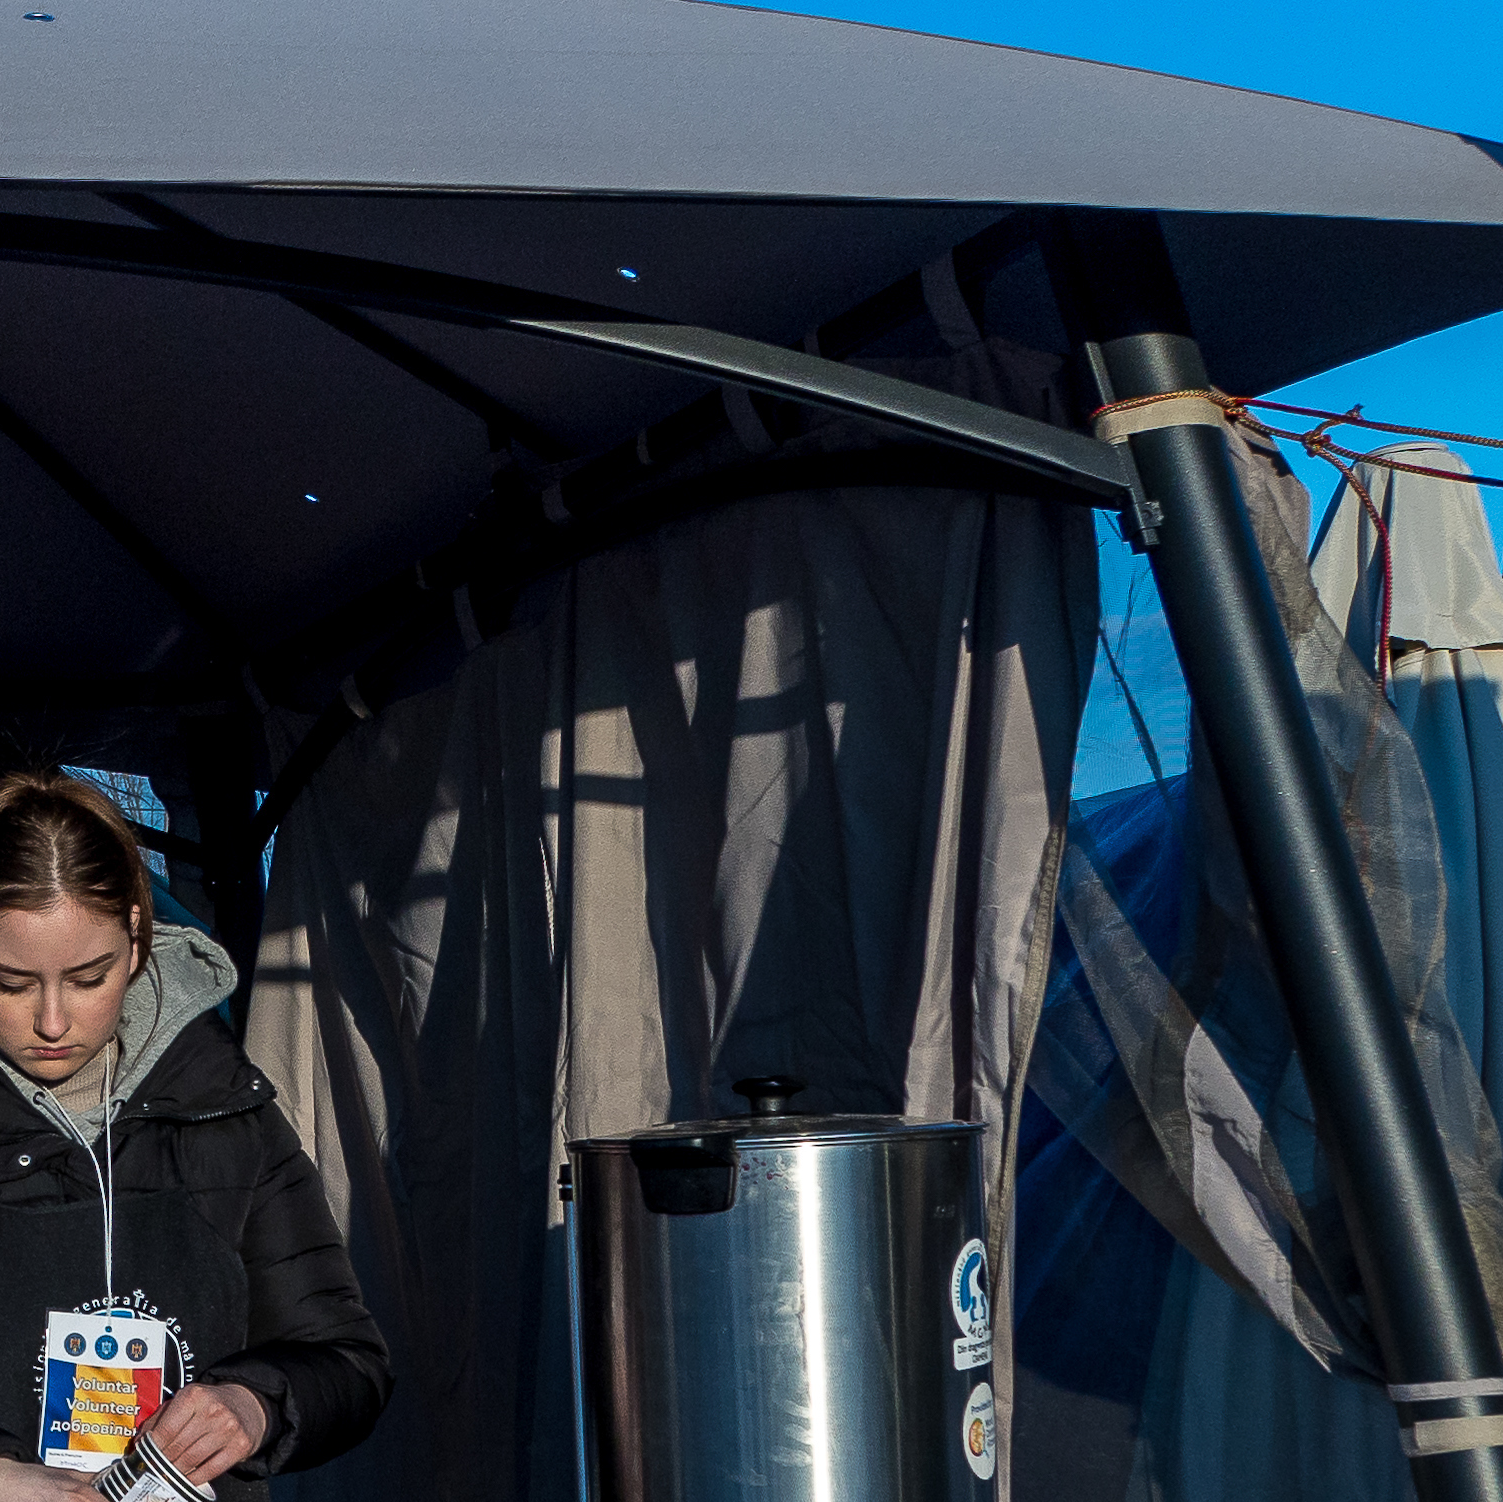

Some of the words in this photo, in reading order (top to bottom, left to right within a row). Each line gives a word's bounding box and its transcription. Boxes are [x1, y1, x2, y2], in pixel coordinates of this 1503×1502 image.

[180, 1341, 195, 1382] mâin
[72, 1376, 138, 1394] Voluntar
[66, 1397, 141, 1415] Volunteer
